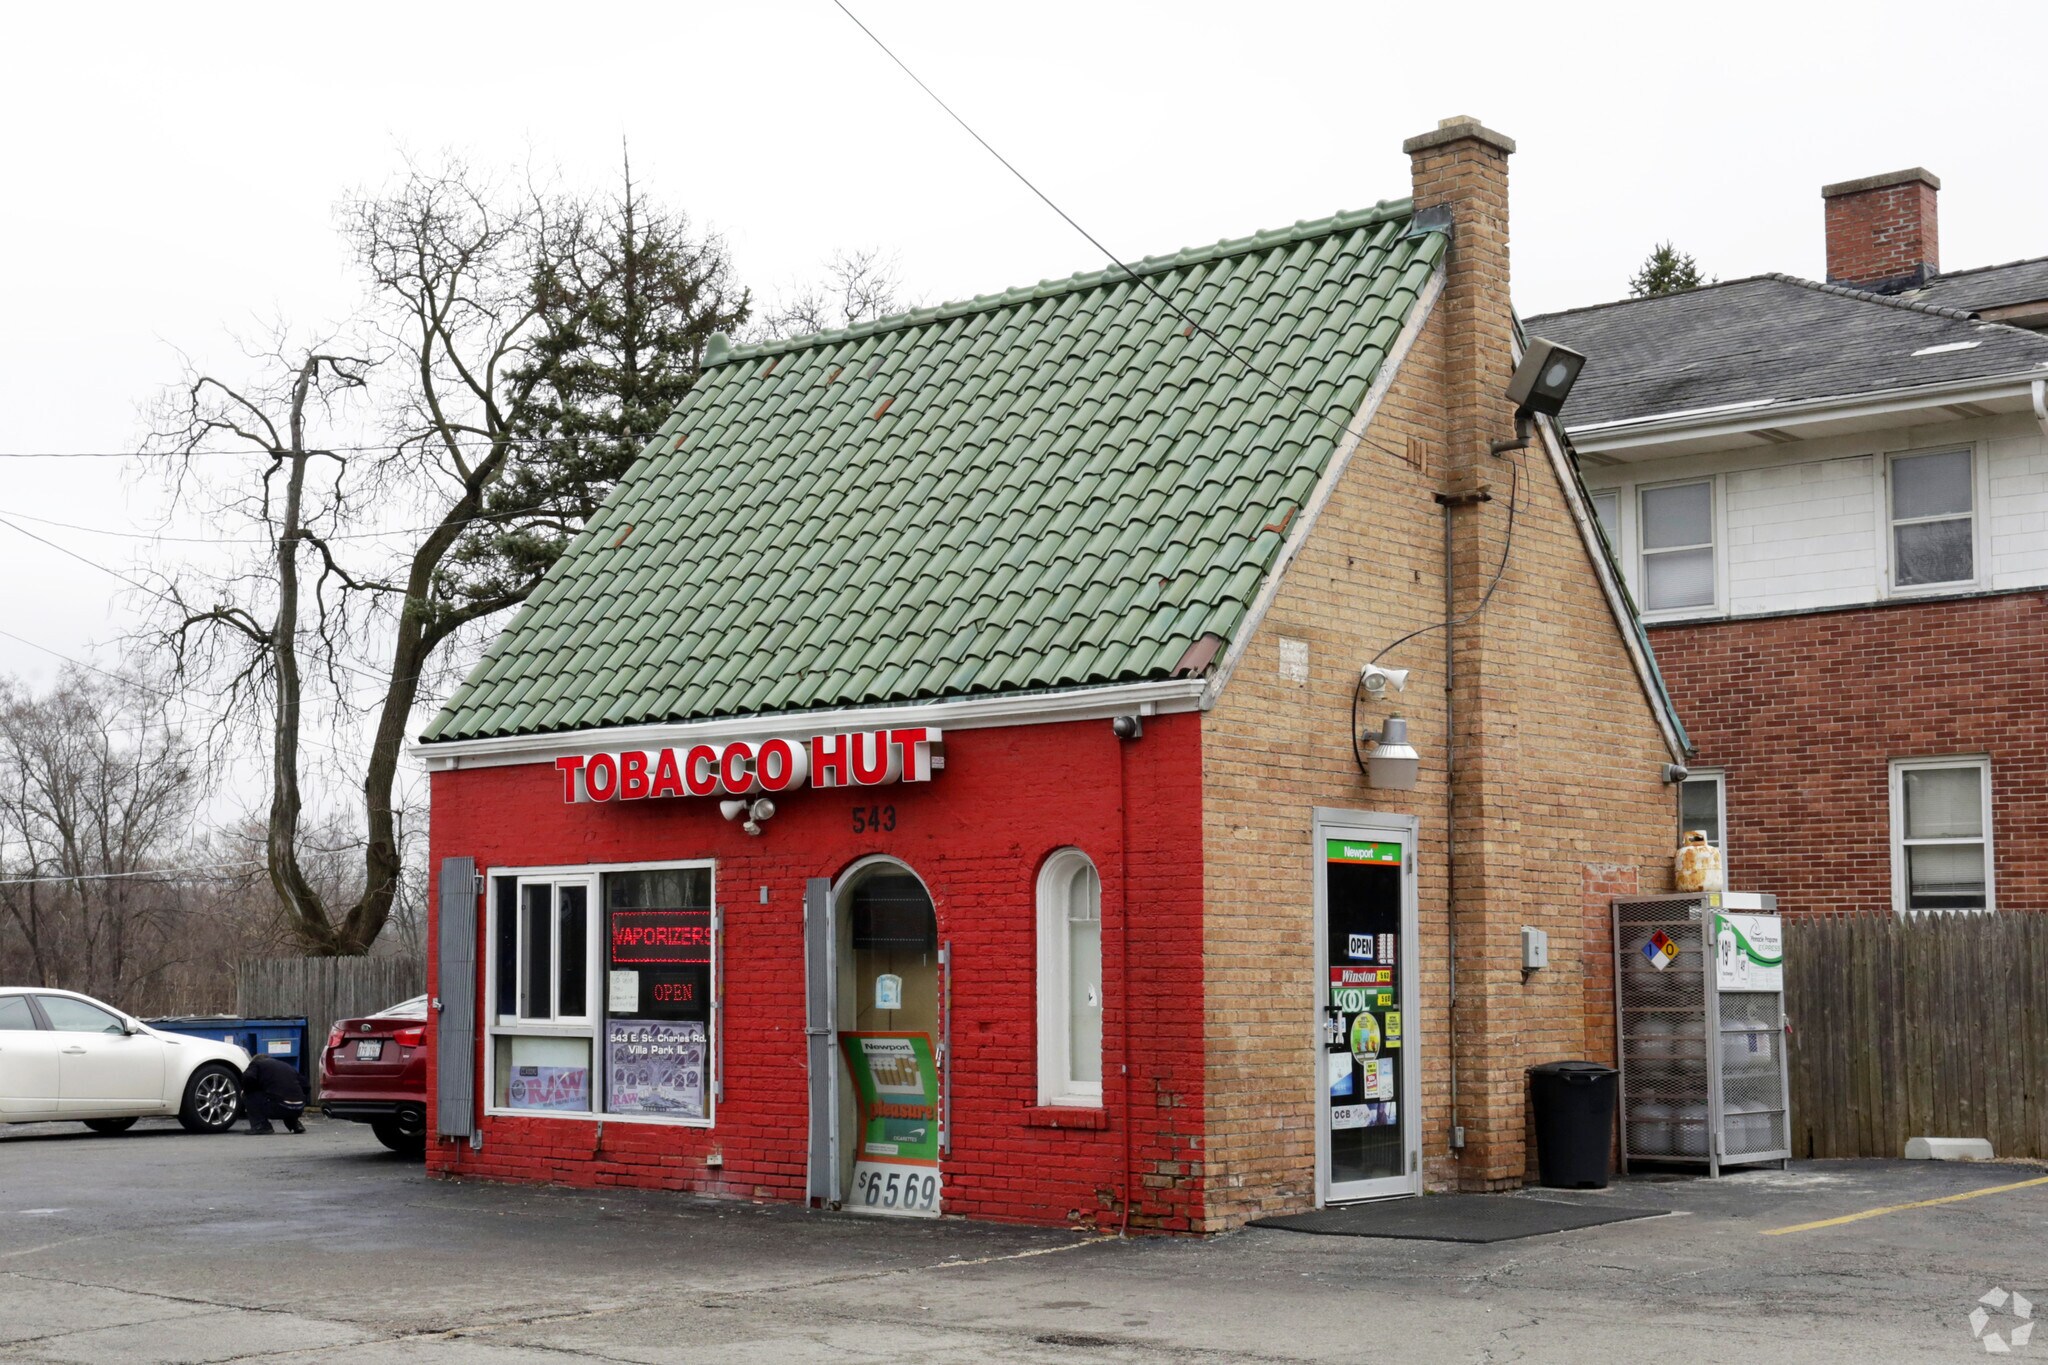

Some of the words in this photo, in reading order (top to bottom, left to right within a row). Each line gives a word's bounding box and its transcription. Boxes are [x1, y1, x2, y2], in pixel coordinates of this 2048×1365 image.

[555, 738, 795, 803] TOBACCO
[811, 727, 928, 788] HUT
[852, 805, 896, 833] 543
[1344, 846, 1374, 858] Newport
[1350, 938, 1372, 955] OPEN
[1666, 944, 1674, 956] 0
[1342, 970, 1376, 983] Winston
[654, 984, 693, 1001] OPEN
[1334, 989, 1370, 1012] KOOL
[610, 1034, 628, 1042] 543
[630, 1034, 639, 1042] E.
[641, 1034, 655, 1042] St.
[657, 1034, 690, 1042] Charles
[692, 1034, 707, 1042] Rd.
[628, 1045, 648, 1055] Villa
[651, 1045, 673, 1055] Park
[677, 1046, 688, 1055] IL.
[864, 1043, 911, 1051] Newport
[526, 1070, 585, 1105] RAW
[613, 1093, 639, 1105] RAW
[1334, 1110, 1351, 1119] OCB
